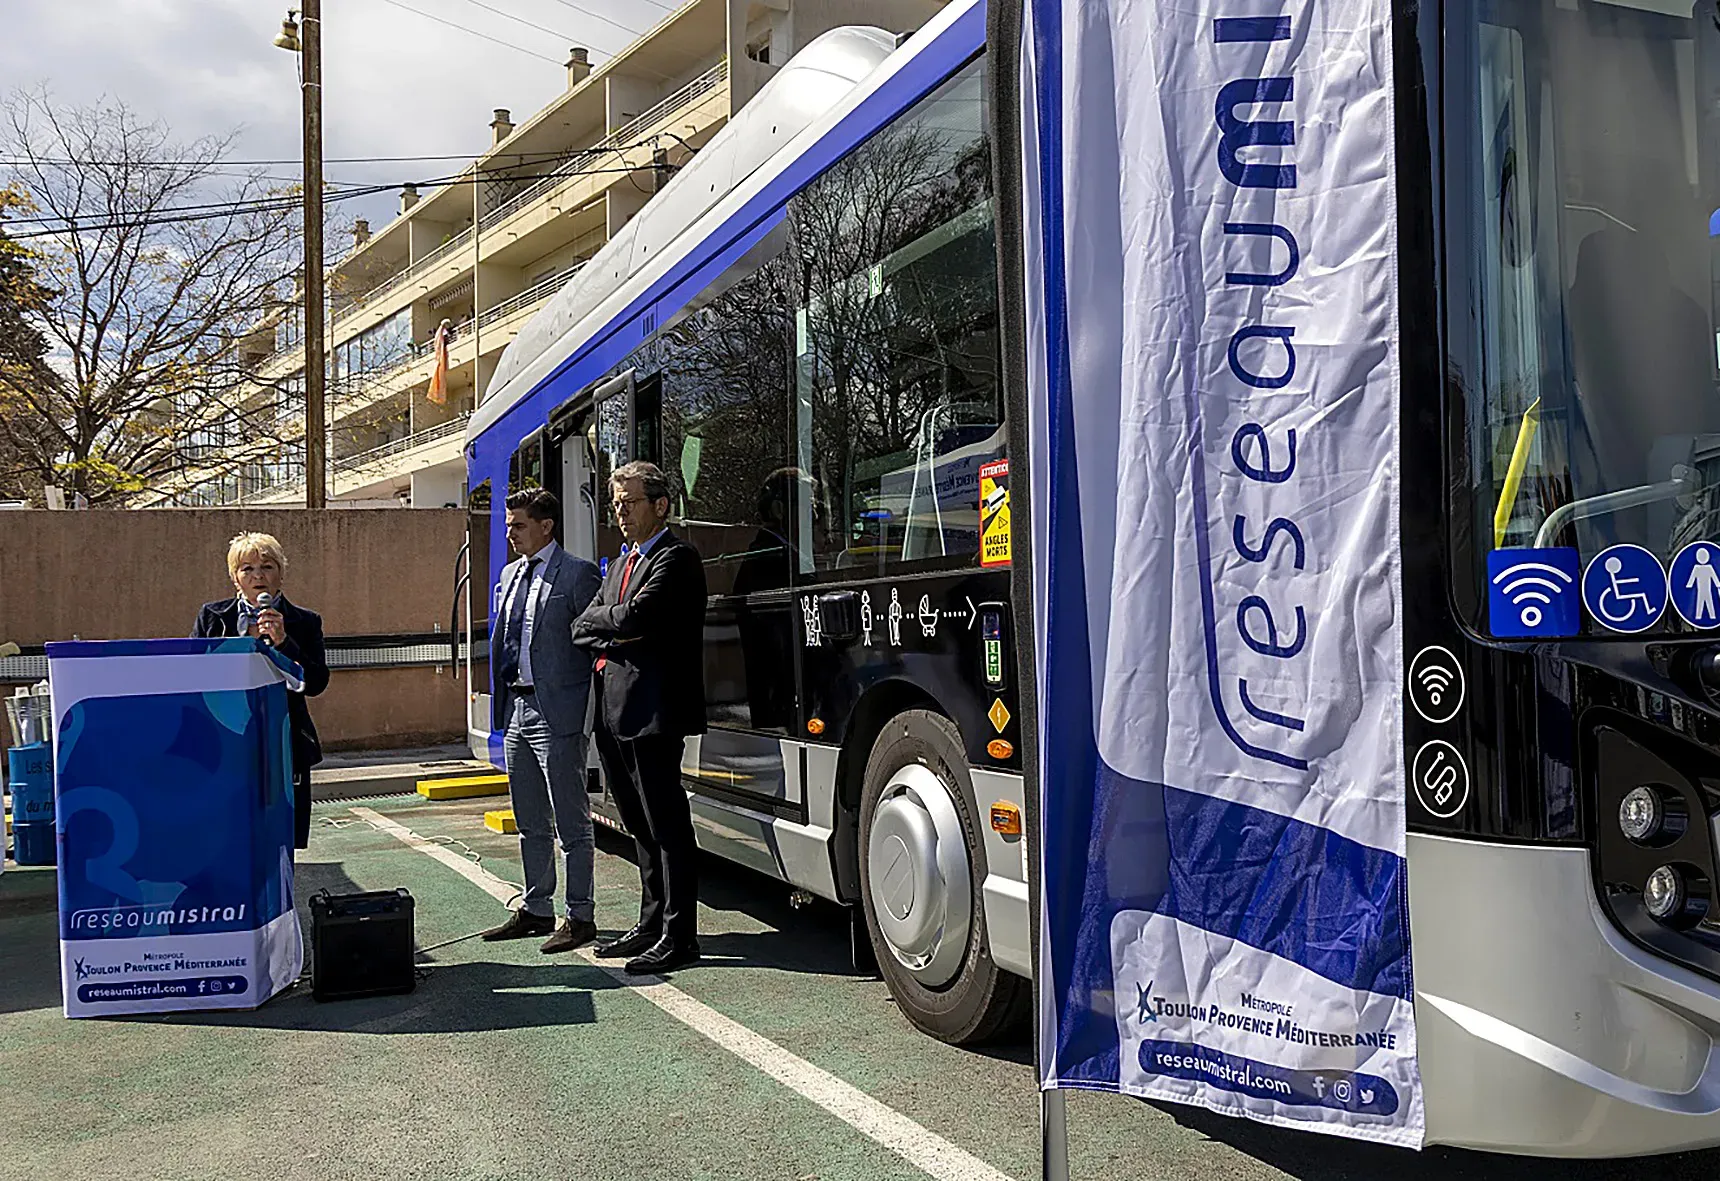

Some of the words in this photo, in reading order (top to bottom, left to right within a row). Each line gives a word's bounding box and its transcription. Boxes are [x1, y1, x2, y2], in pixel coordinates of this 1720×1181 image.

[985, 534, 1009, 546] ANGLES
[986, 546, 1008, 557] MORTS
[26, 760, 42, 775] Les
[26, 800, 40, 813] du
[71, 904, 246, 929] reseaumistral
[86, 964, 121, 975] TOULON
[124, 961, 171, 973] PROVENCE
[174, 956, 247, 970] MÉDITERRANÉE
[88, 983, 187, 998] reseaumistral.com
[1240, 992, 1293, 1017] MÉTROPOLE
[1154, 996, 1207, 1023] TOULON
[1209, 1006, 1273, 1039] PROVENCE
[1275, 1018, 1397, 1051] MÉDITERRANÉE
[1155, 1050, 1293, 1096] reseaumistral.com
